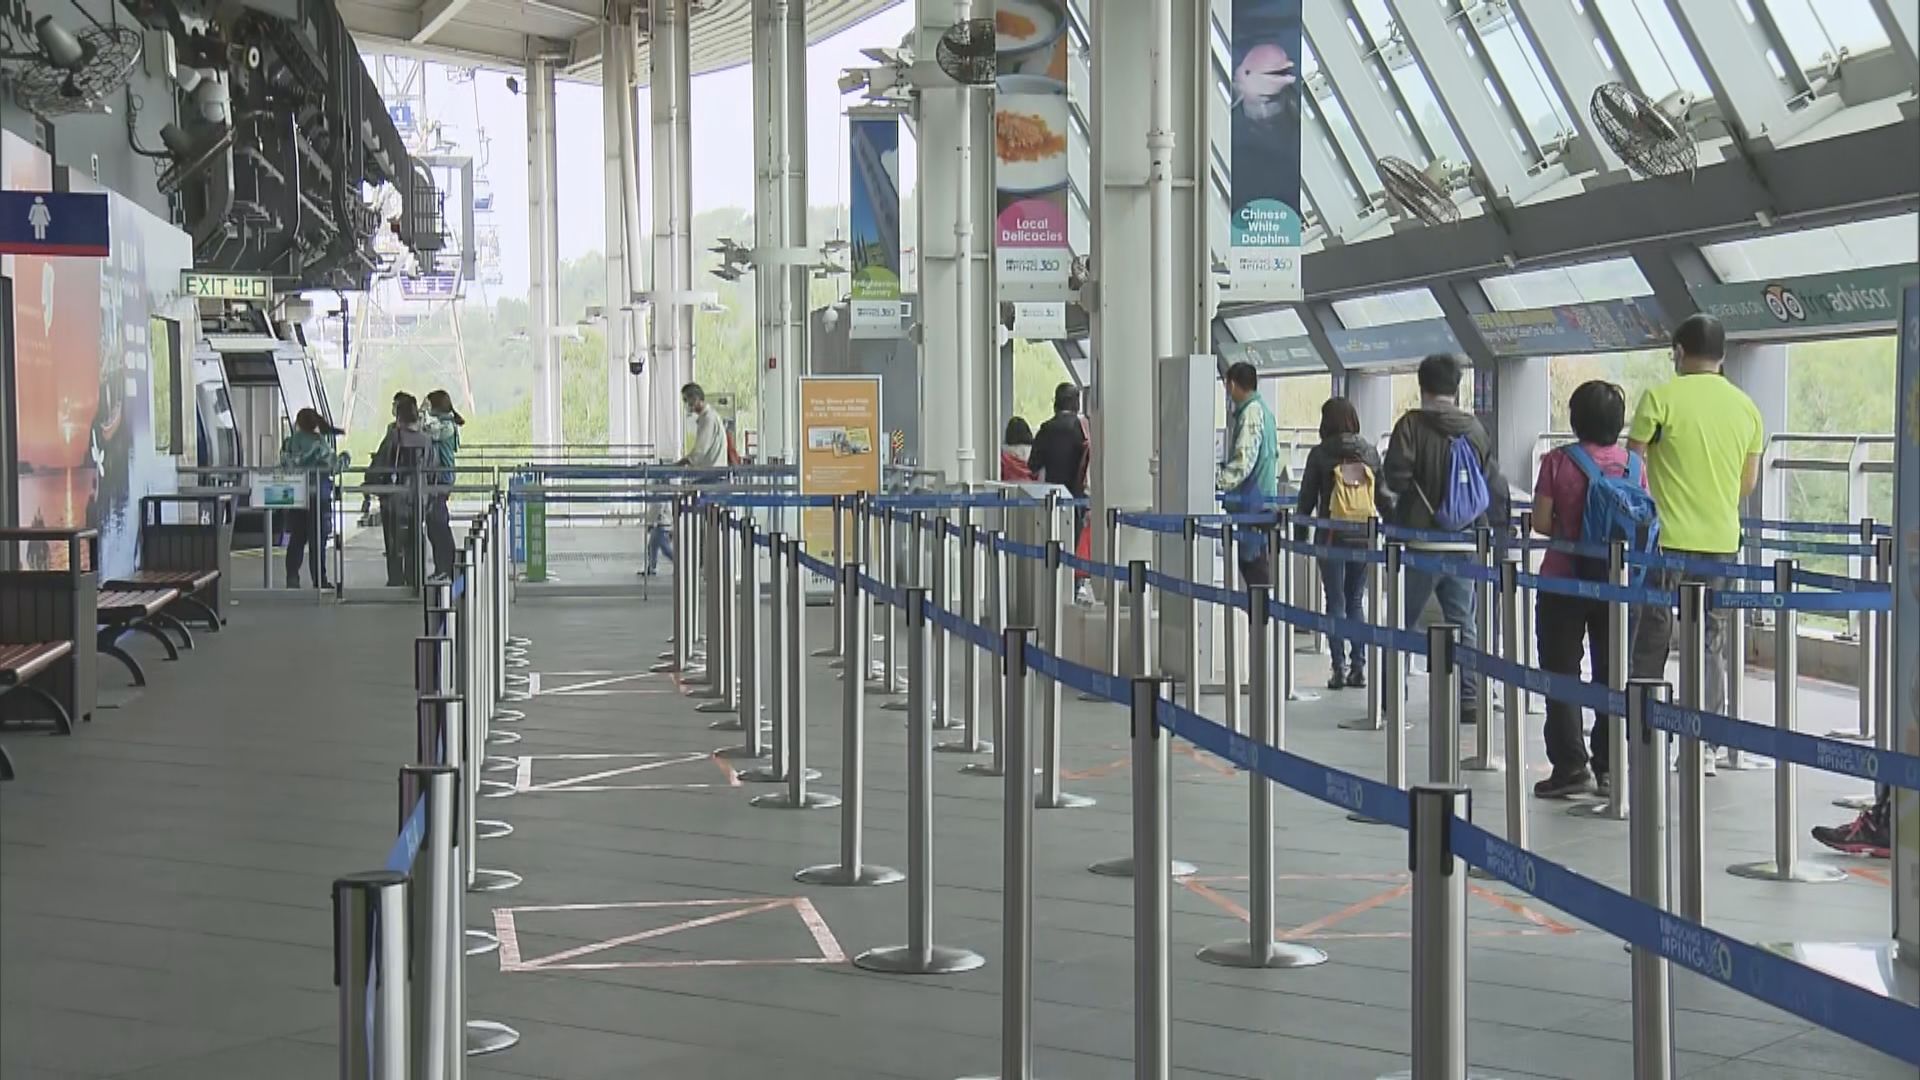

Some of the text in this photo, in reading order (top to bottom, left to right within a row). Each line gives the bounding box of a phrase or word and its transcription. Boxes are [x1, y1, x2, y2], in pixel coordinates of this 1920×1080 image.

[1240, 209, 1287, 220] Chinese
[1016, 218, 1048, 230] Local
[1248, 221, 1280, 232] White
[1002, 230, 1063, 241] Delicacies
[1241, 233, 1290, 245] Dolphins
[186, 276, 228, 295] EXIT
